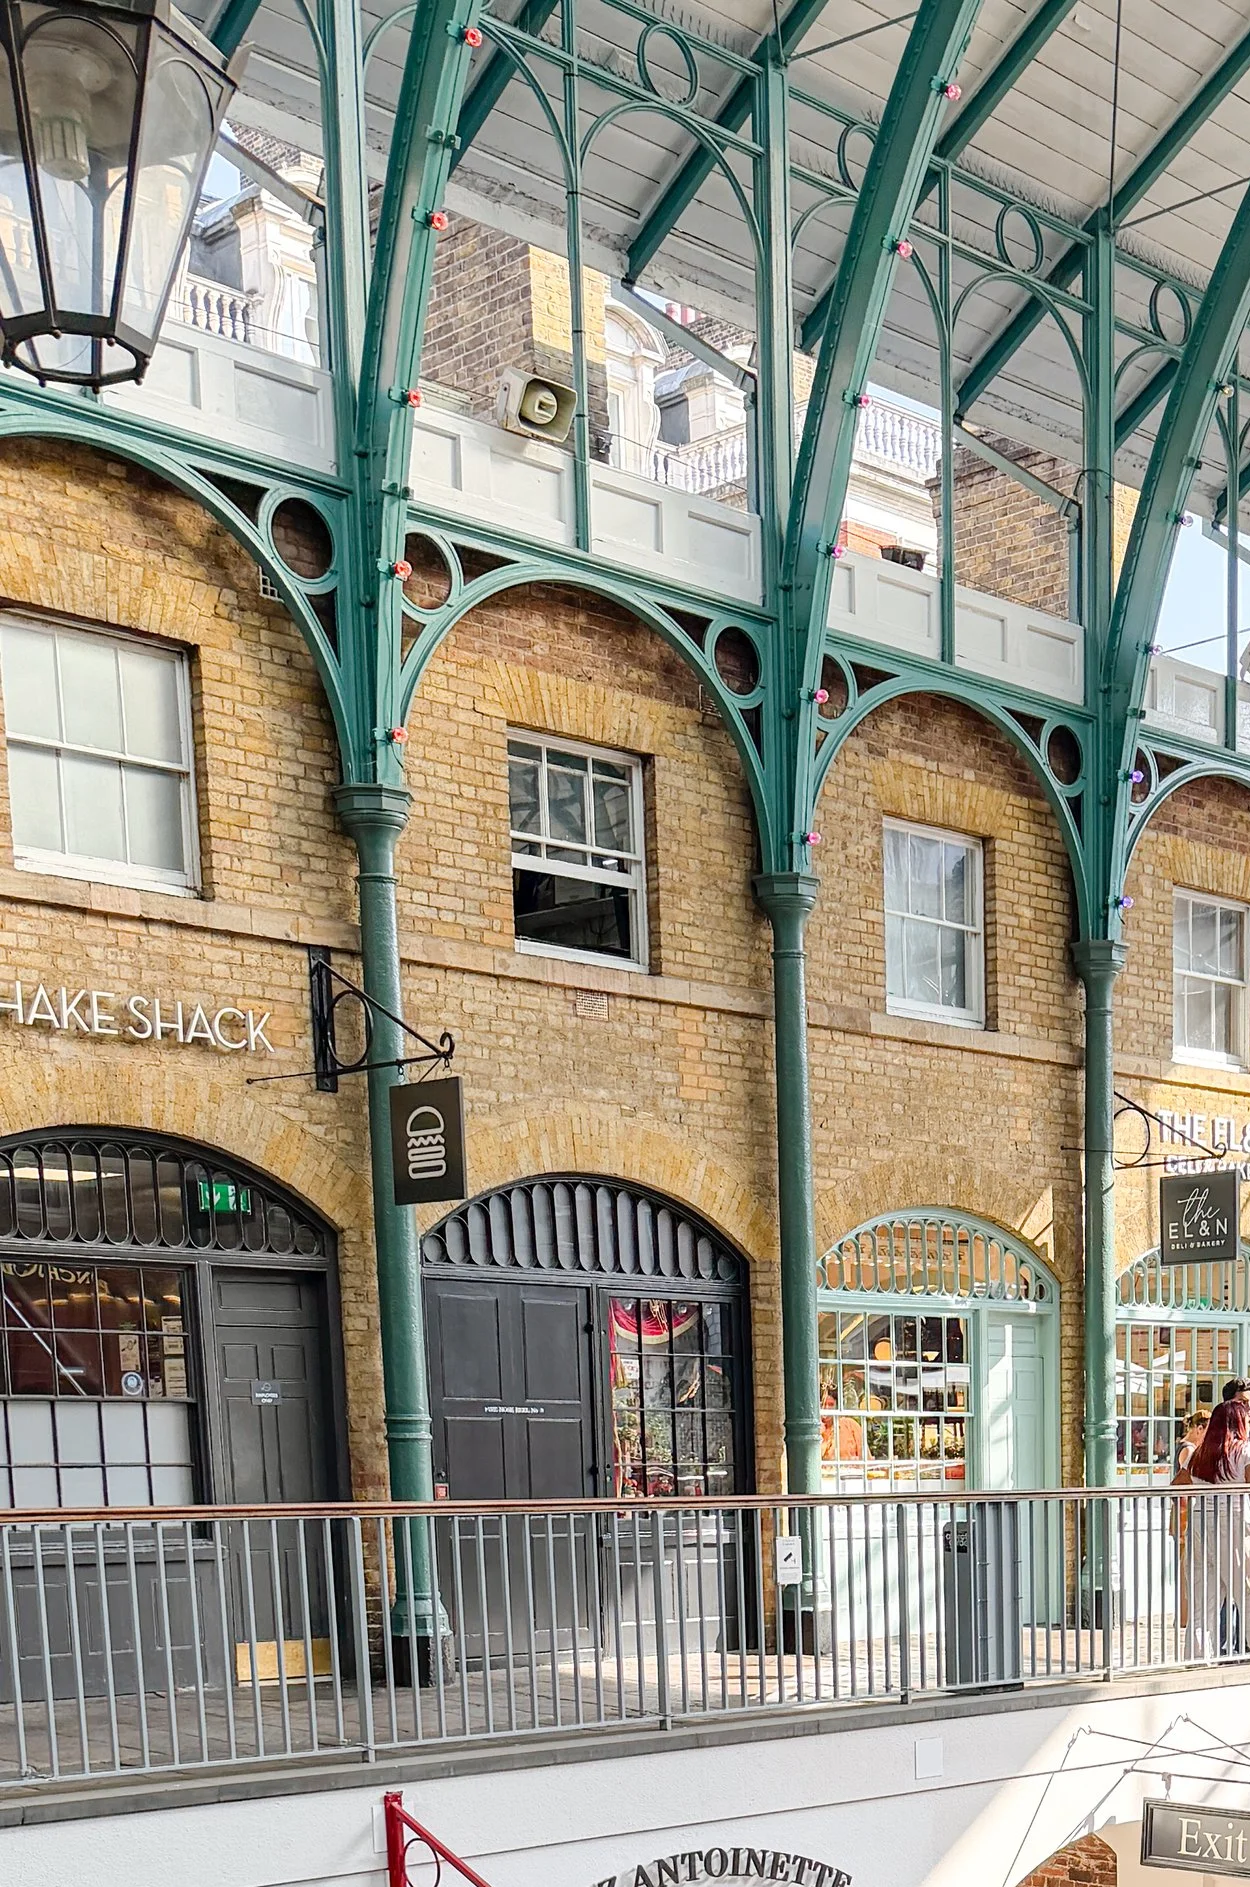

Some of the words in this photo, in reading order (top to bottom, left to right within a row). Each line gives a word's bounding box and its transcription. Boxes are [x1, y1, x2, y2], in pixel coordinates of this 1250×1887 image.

[127, 995, 275, 1053] SHACK
[1157, 1109, 1207, 1147] THE
[1177, 1187, 1221, 1224] the
[1170, 1242, 1188, 1250] DELI
[1196, 1239, 1226, 1248] BAKERY
[1177, 1817, 1248, 1863] Exit
